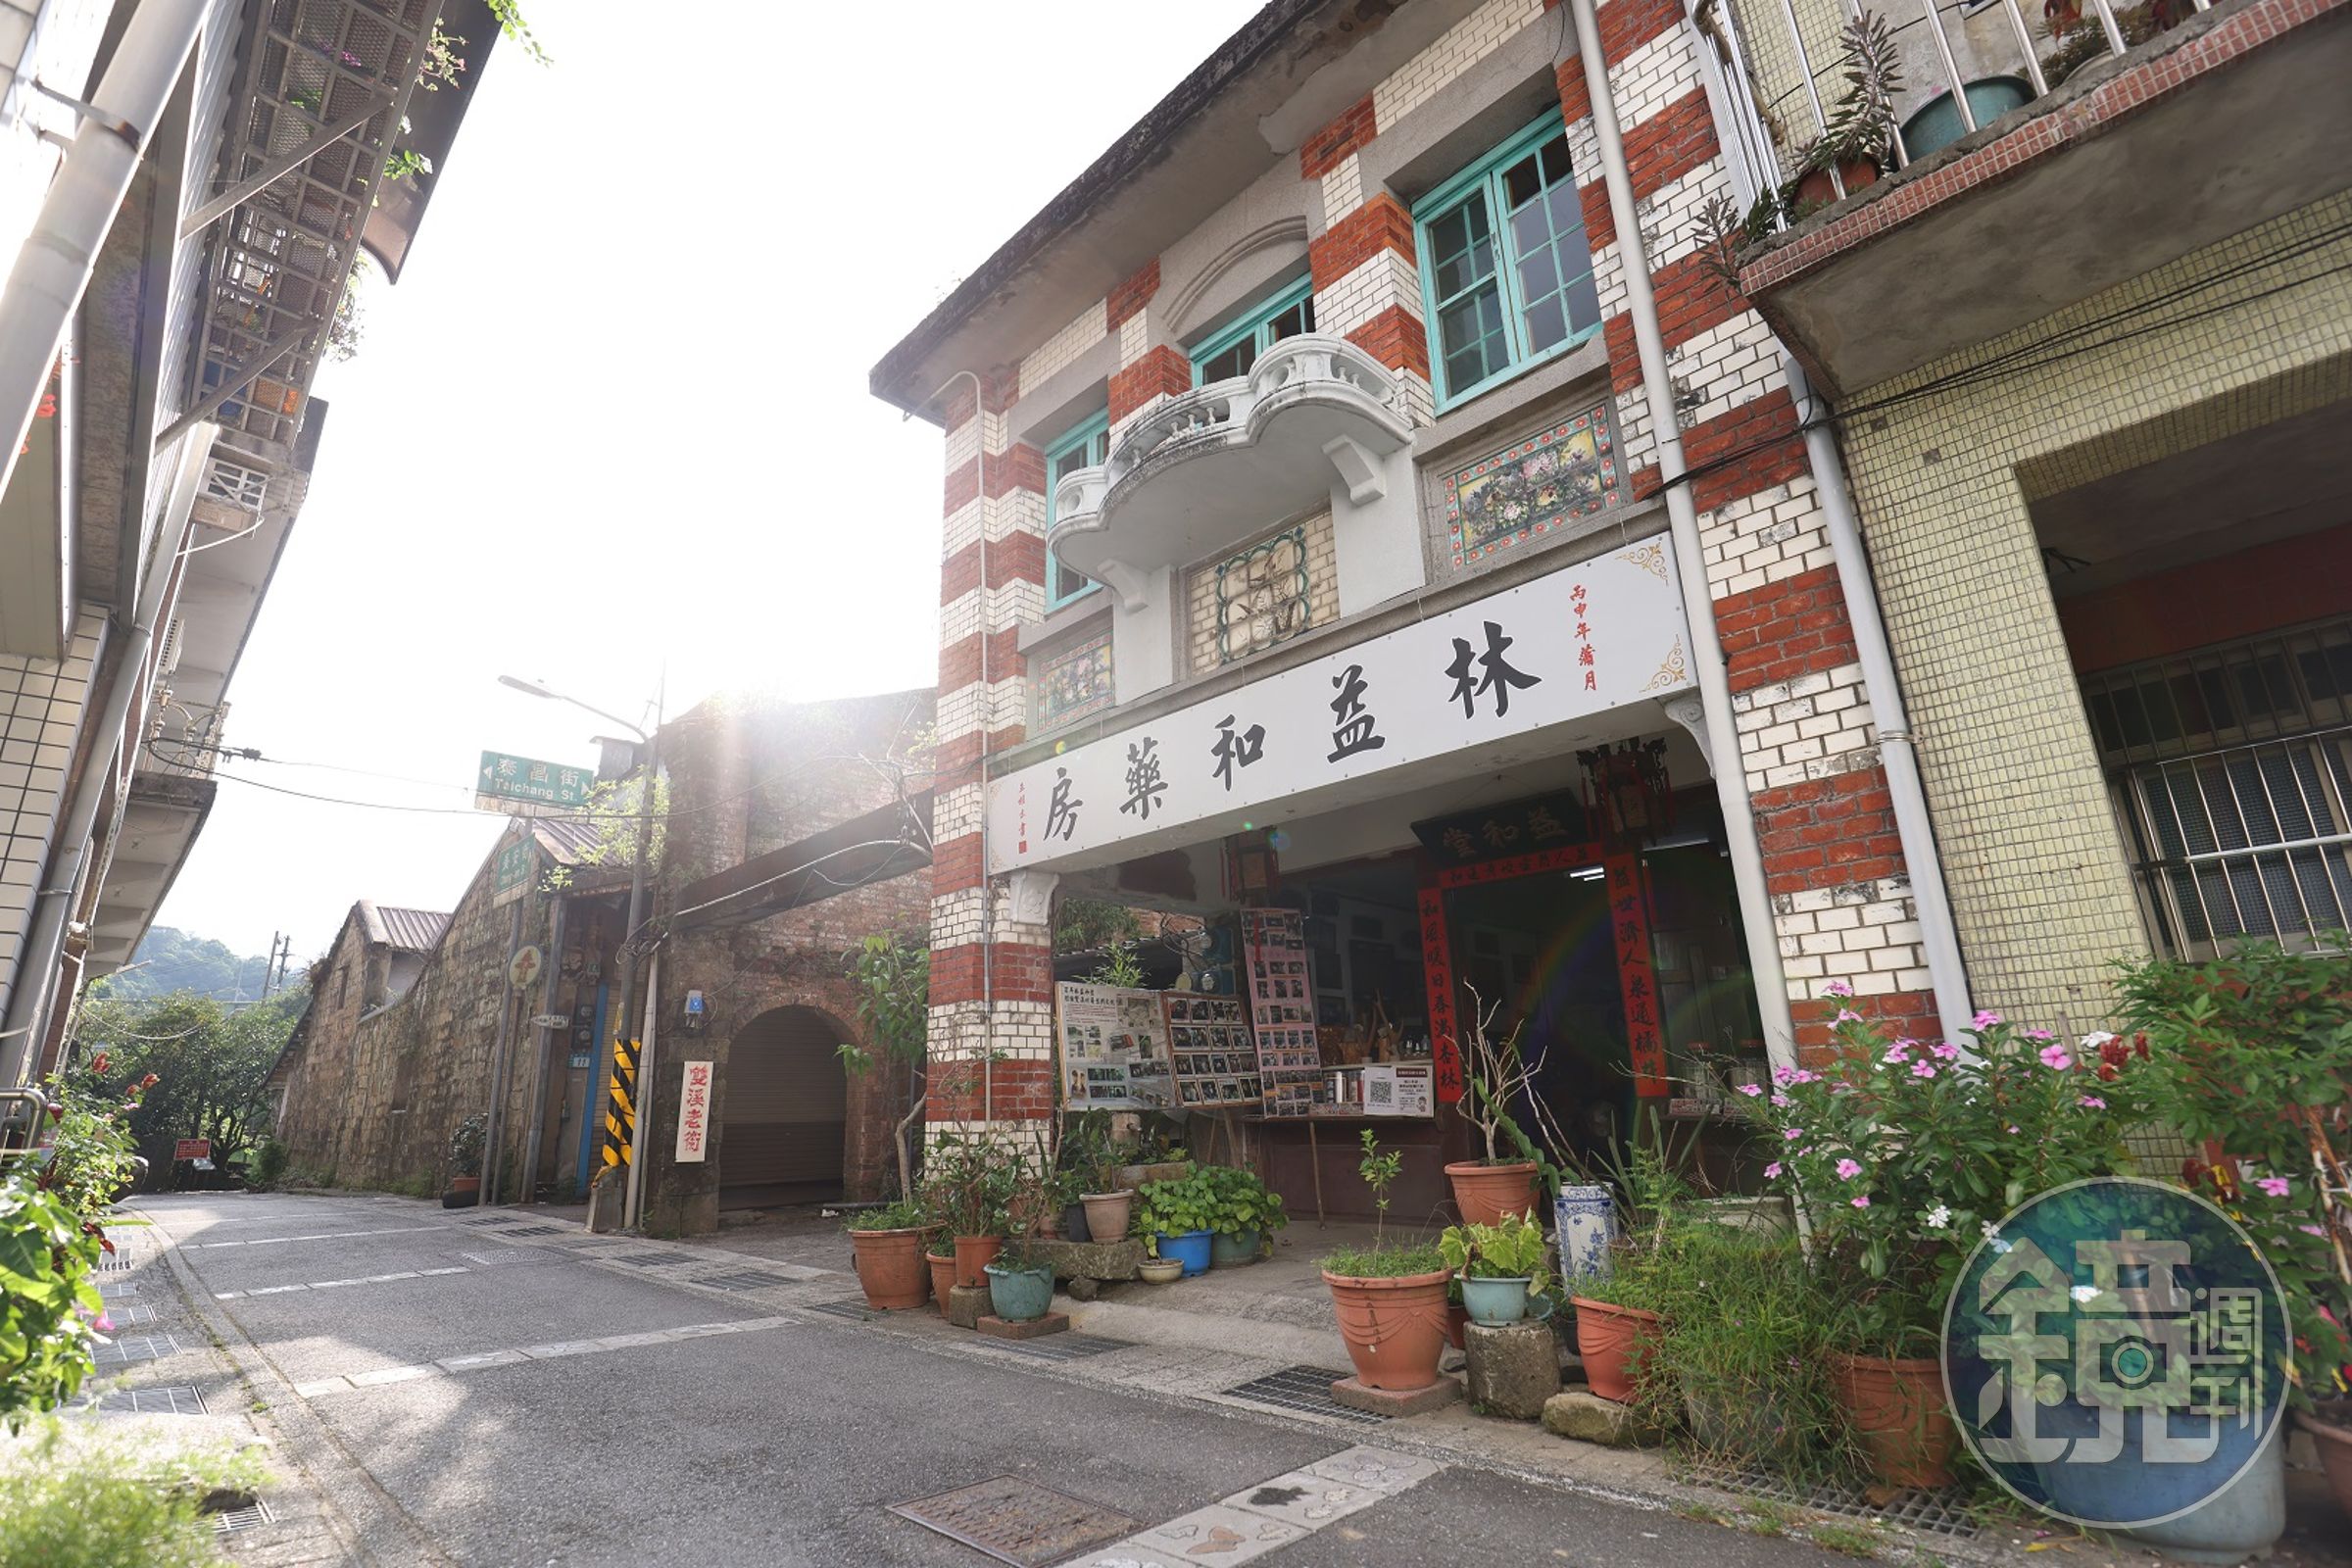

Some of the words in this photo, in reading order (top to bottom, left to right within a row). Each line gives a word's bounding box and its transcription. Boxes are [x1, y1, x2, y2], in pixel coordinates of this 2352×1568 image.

[1569, 584, 1596, 691] 丙申年蒲月
[1043, 621, 1542, 842] 林益和藥房
[495, 778, 555, 800] Taichang
[562, 789, 578, 802] St.
[1442, 805, 1569, 858] 益和堂
